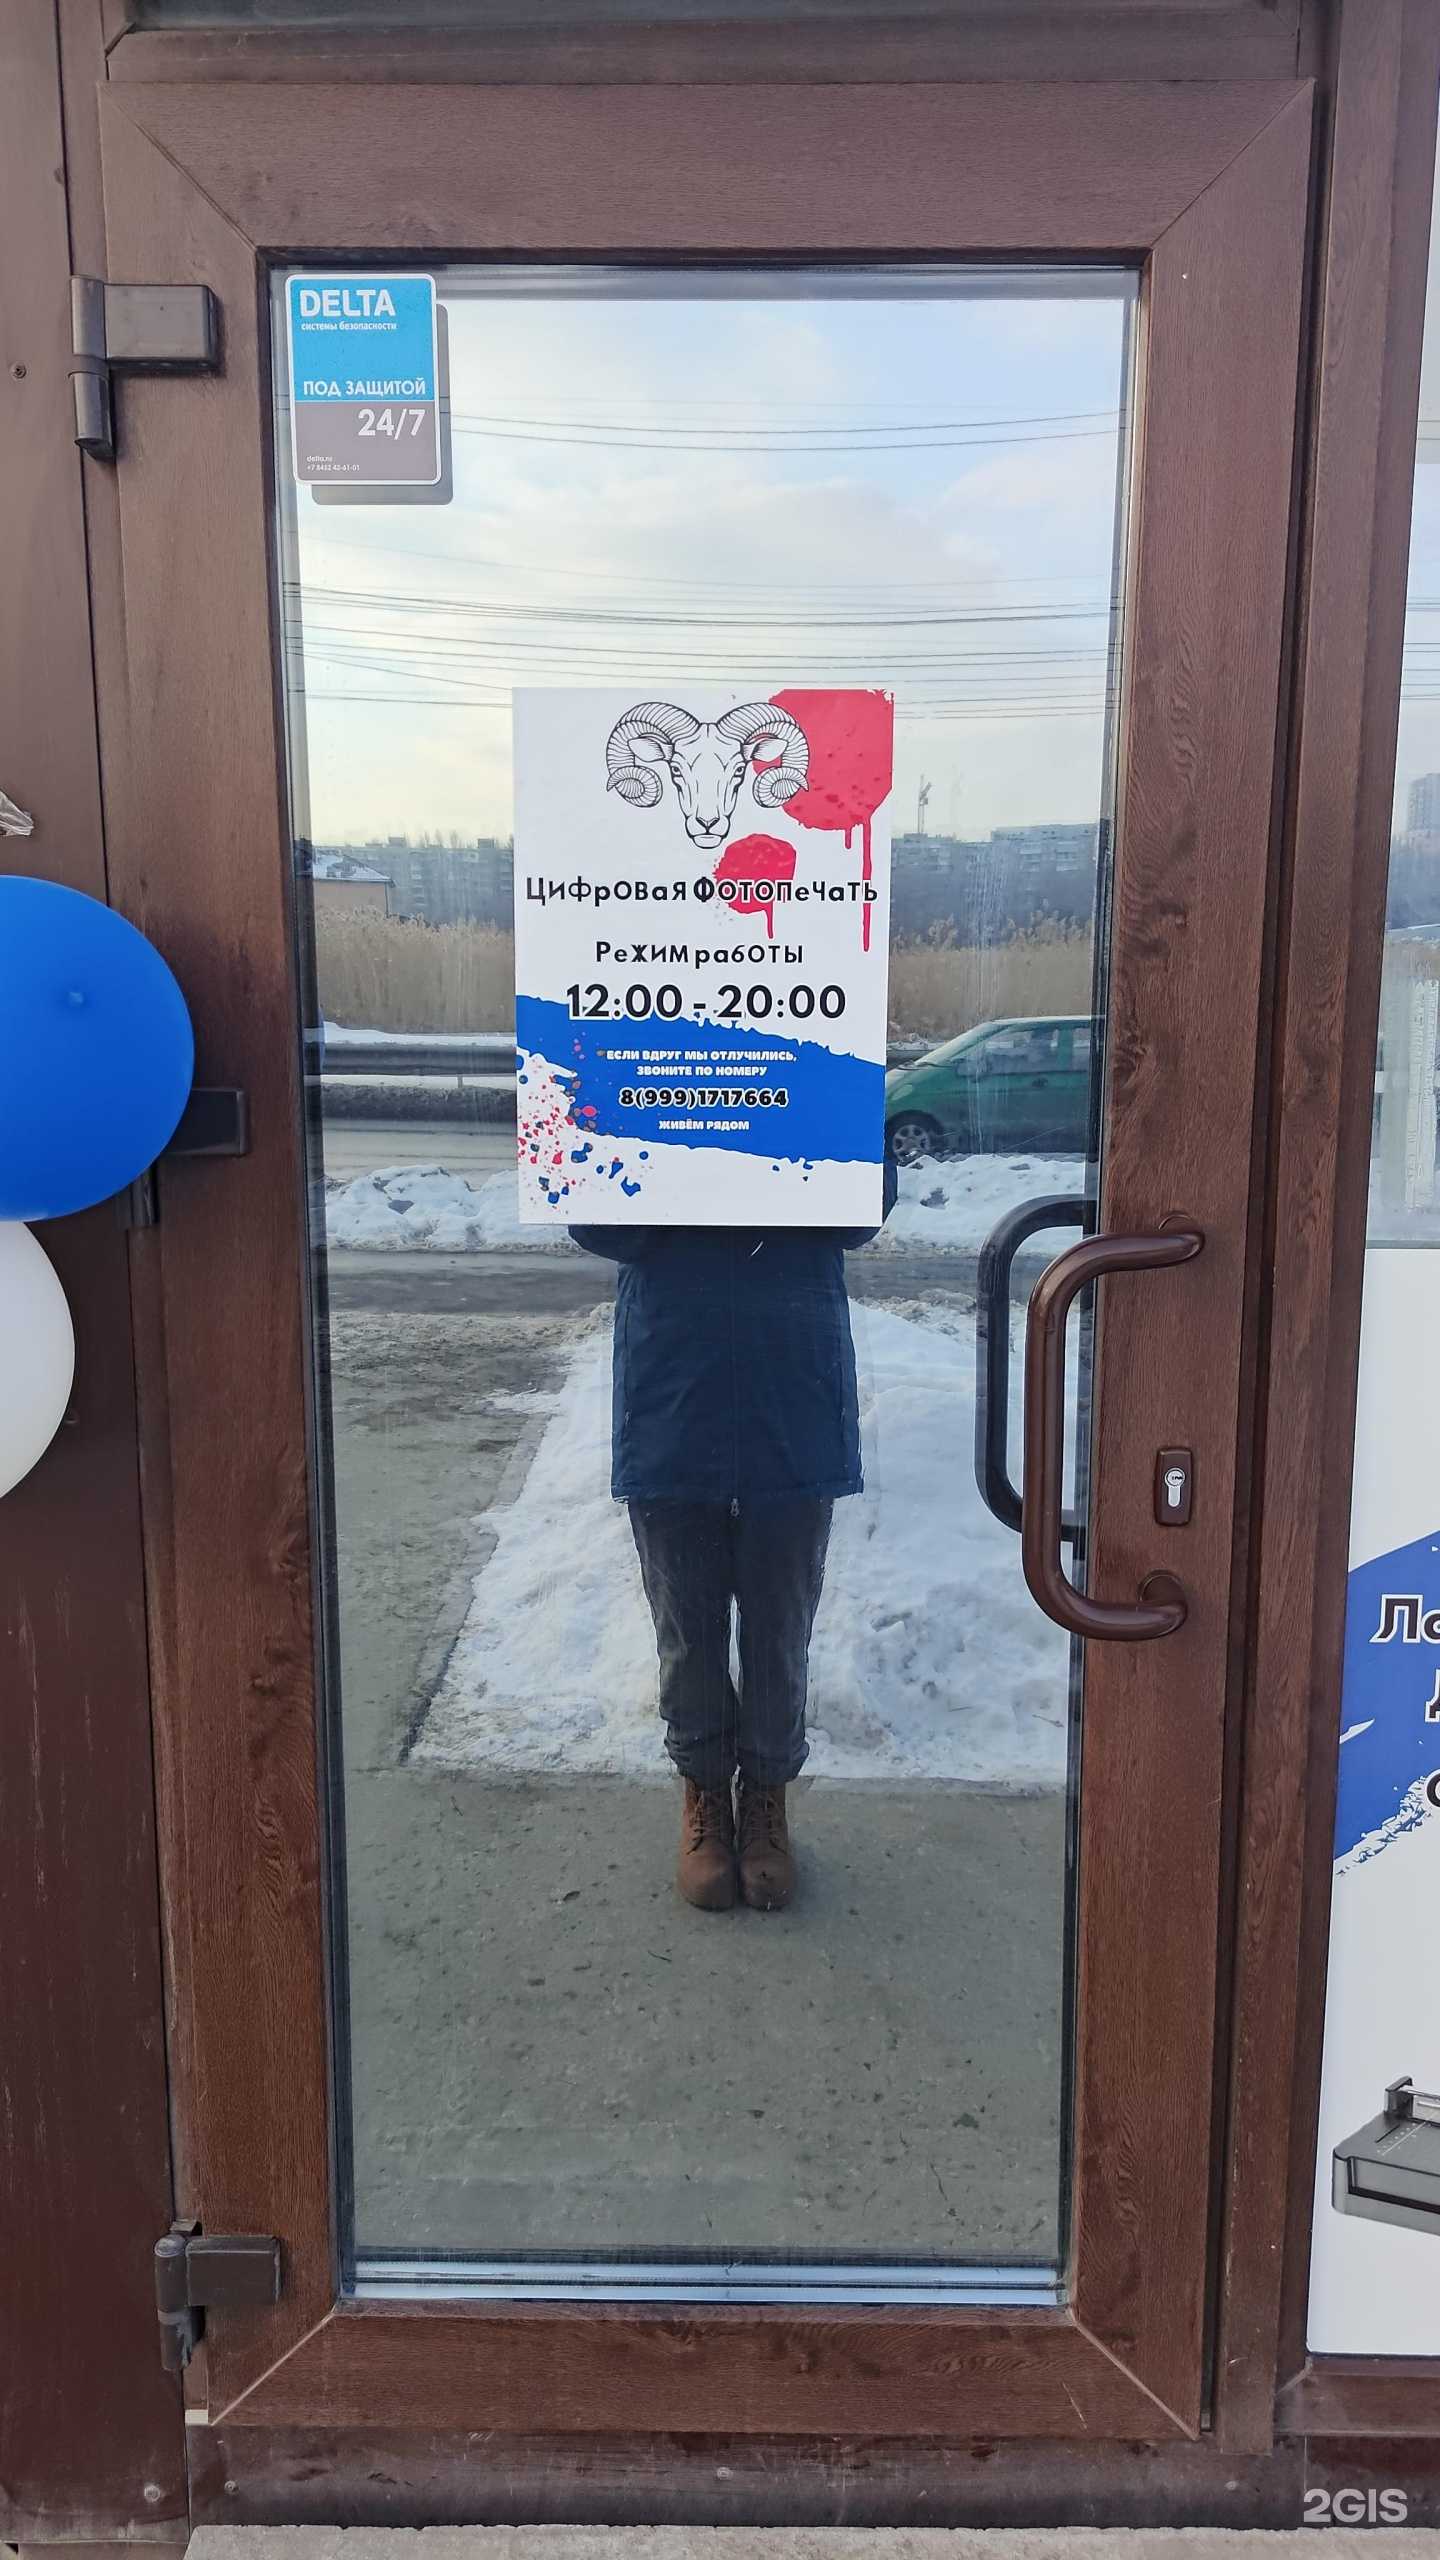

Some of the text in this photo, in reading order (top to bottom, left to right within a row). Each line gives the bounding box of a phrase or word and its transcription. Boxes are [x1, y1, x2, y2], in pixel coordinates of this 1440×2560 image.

[299, 288, 396, 317] DELTA
[301, 320, 397, 332] системы безопасности
[303, 377, 426, 397] ПОД ЗАЩИТОЙ
[358, 408, 426, 440] 24/7
[566, 983, 683, 1018] 12:00
[716, 984, 846, 1019] 20:00
[606, 1050, 797, 1063] ЕСЛИ ВДРУГ МЫ ОТЛУЧИЛИСЬ,
[636, 1065, 767, 1077] ЗВОНИТЕ ПО НОМЕРУ
[619, 1088, 788, 1109] 8(999)1717664
[658, 1118, 750, 1131] ЖИВЁМ РЯДОМ
